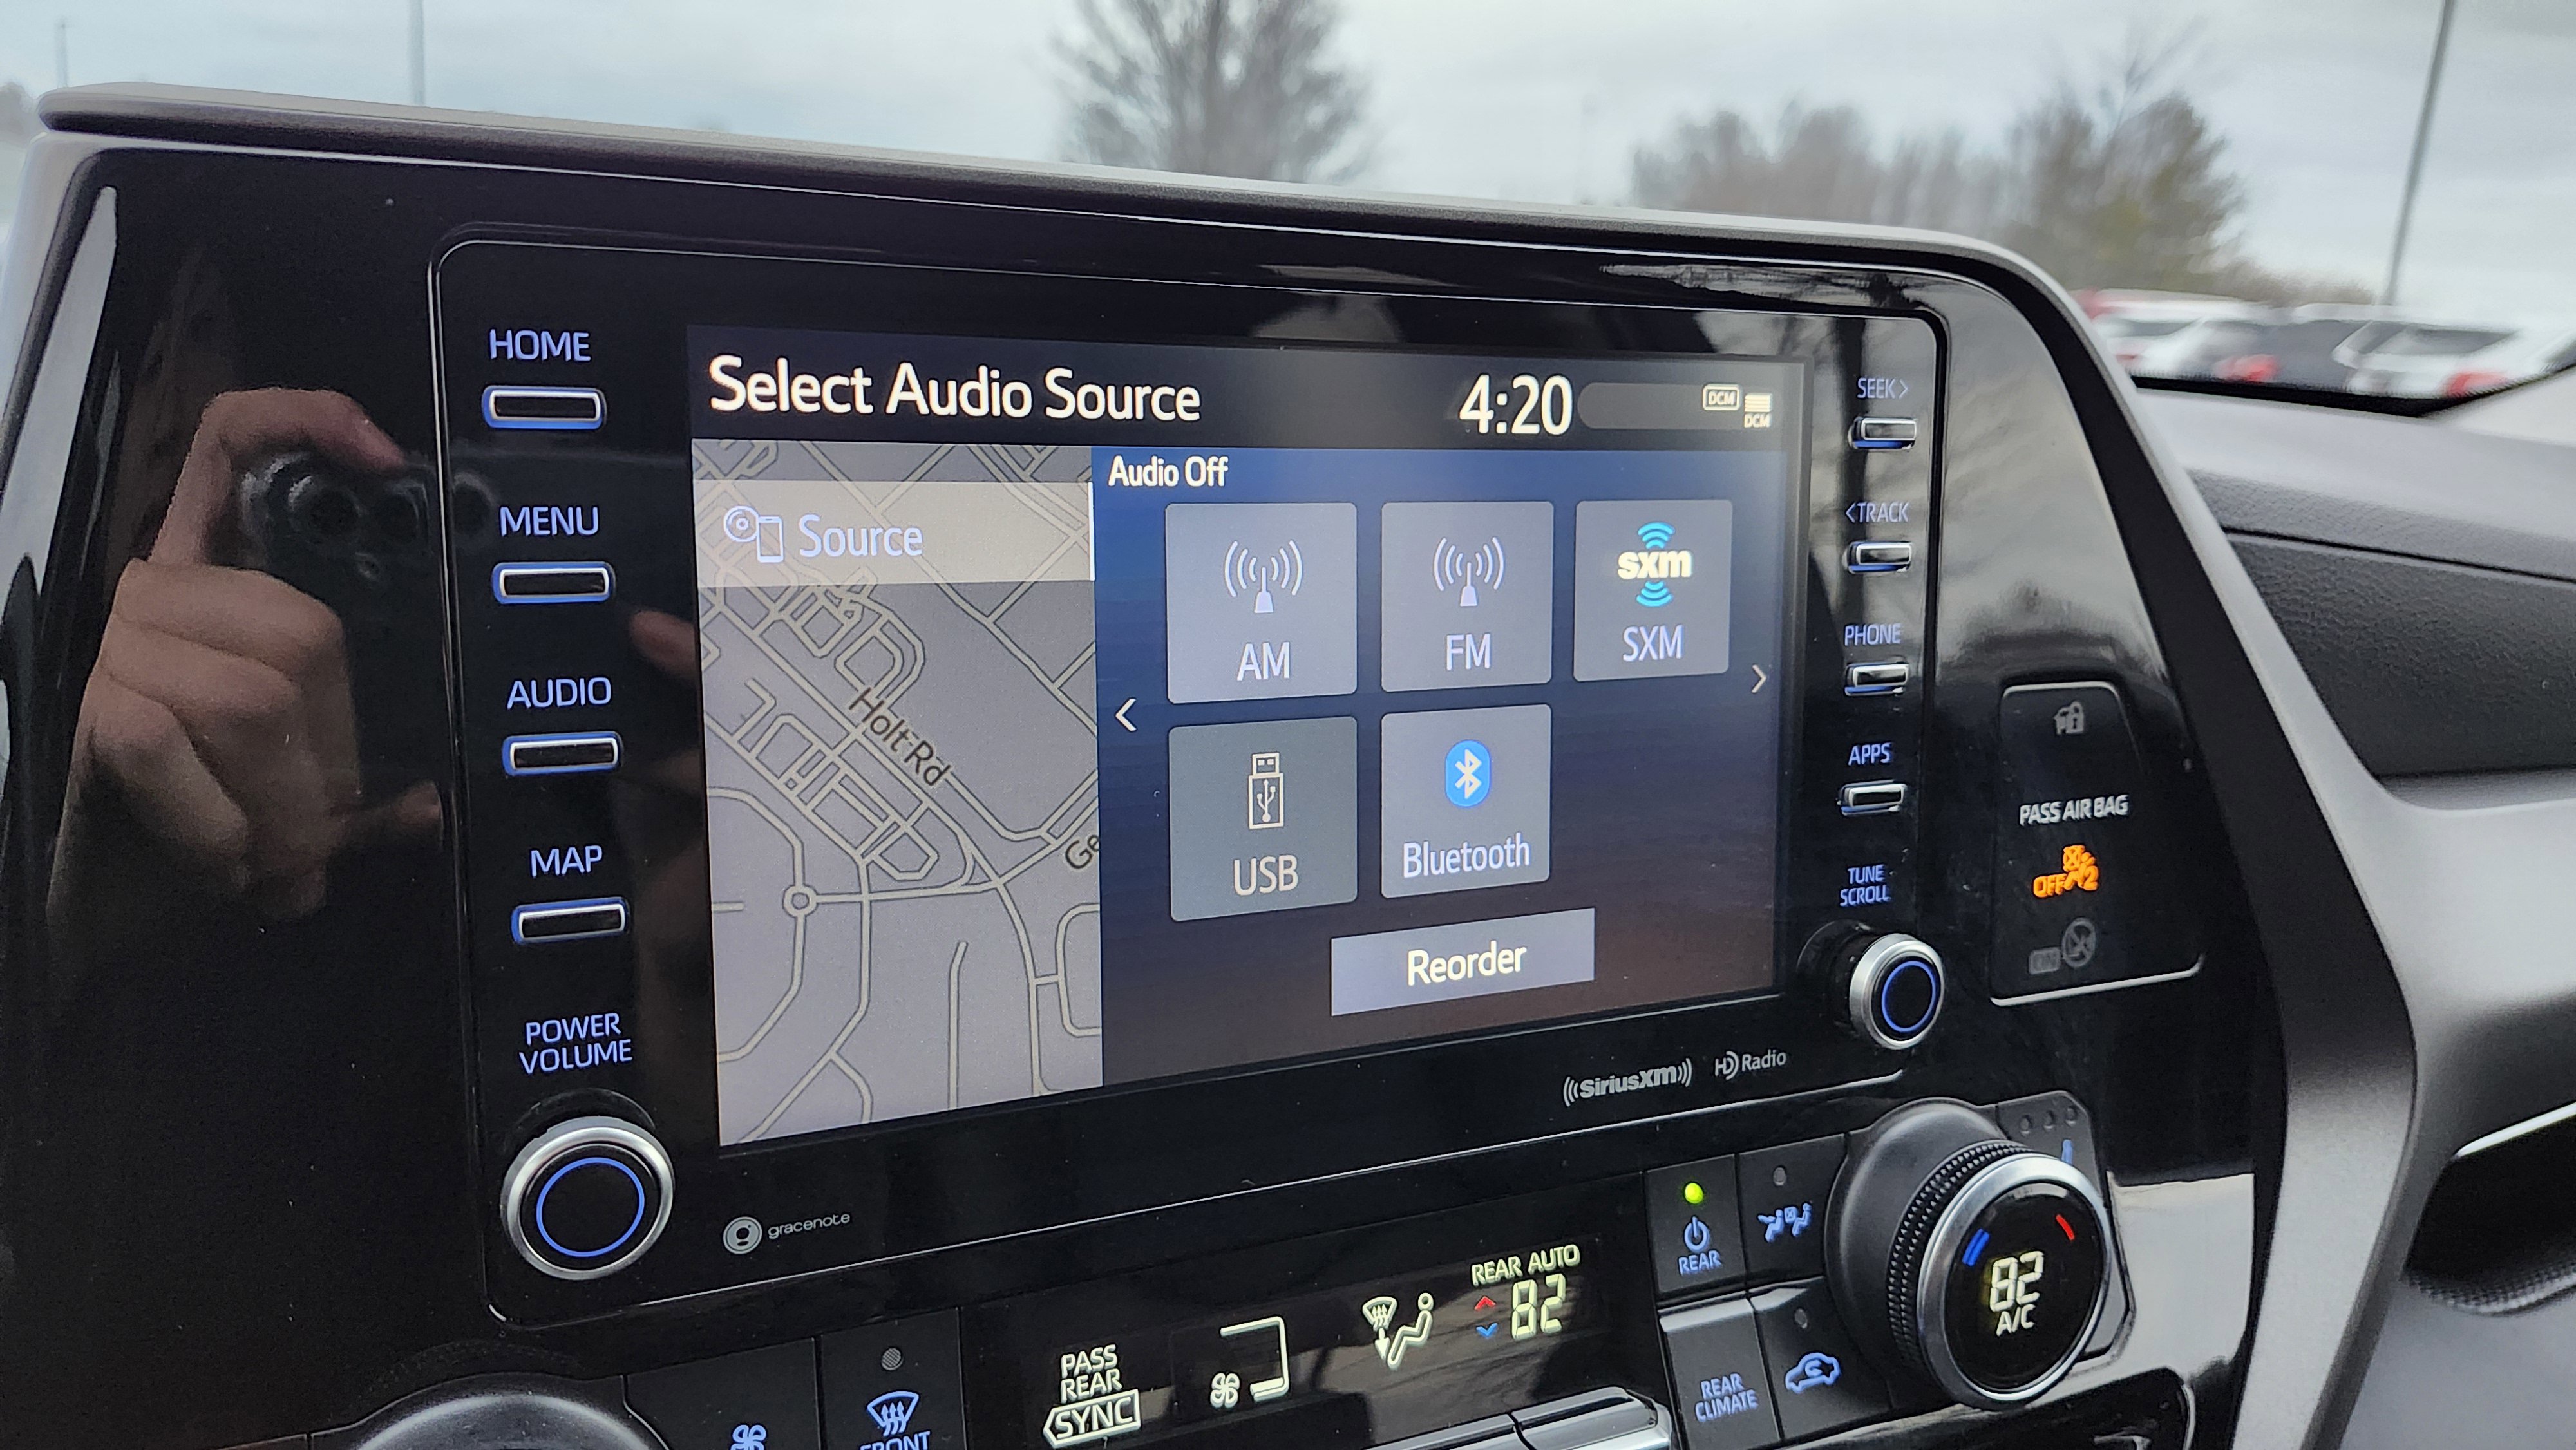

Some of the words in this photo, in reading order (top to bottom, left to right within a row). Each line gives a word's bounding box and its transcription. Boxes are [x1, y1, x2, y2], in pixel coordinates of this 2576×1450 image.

[489, 329, 591, 362] HOME
[709, 355, 874, 414] Select
[886, 362, 1031, 419] Audio
[1045, 367, 1201, 421] Source
[1459, 374, 1573, 435] 4:20
[1708, 390, 1735, 406] DCM
[1744, 413, 1770, 428] DCM
[1108, 455, 1180, 488] Audio
[1185, 455, 1229, 487] Off
[499, 506, 599, 536] MENU
[799, 515, 923, 557] Source
[1623, 625, 1682, 661] SXM
[1844, 623, 1902, 646] PHONE
[1237, 643, 1290, 681] AM
[1446, 633, 1491, 670] FM
[507, 677, 611, 708] AUDIO
[848, 688, 907, 753] Holt
[904, 740, 951, 786] Rd
[1848, 742, 1892, 766] APPS
[2020, 802, 2061, 826] PASS
[2063, 798, 2092, 820] AIR
[2094, 795, 2128, 818] BAG
[530, 845, 603, 877] MAP
[1403, 833, 1530, 878] Bluetooth
[1234, 855, 1298, 896] USB
[1848, 864, 1884, 883] TUNE
[2034, 873, 2067, 898] OFF
[1840, 884, 1889, 906] SCROLL
[1407, 941, 1527, 986] Reorder
[525, 1013, 621, 1045] POWER
[519, 1039, 632, 1075] VOLUME
[1742, 1049, 1786, 1071] Radio
[768, 1212, 851, 1239] gracenote
[1472, 1257, 1522, 1286] REAR
[1528, 1243, 1580, 1276] AUTO
[1678, 1249, 1721, 1274] REAR
[1989, 1251, 2043, 1312] 82
[1511, 1275, 1565, 1339] 82
[1996, 1304, 2034, 1335] A/C
[1061, 1344, 1117, 1379] PASS
[1060, 1369, 1122, 1404] REAR
[1701, 1373, 1743, 1399] REAR
[1054, 1398, 1132, 1440] SYNC
[1694, 1389, 1759, 1422] CLIMATE
[860, 1431, 930, 1450] ONT
